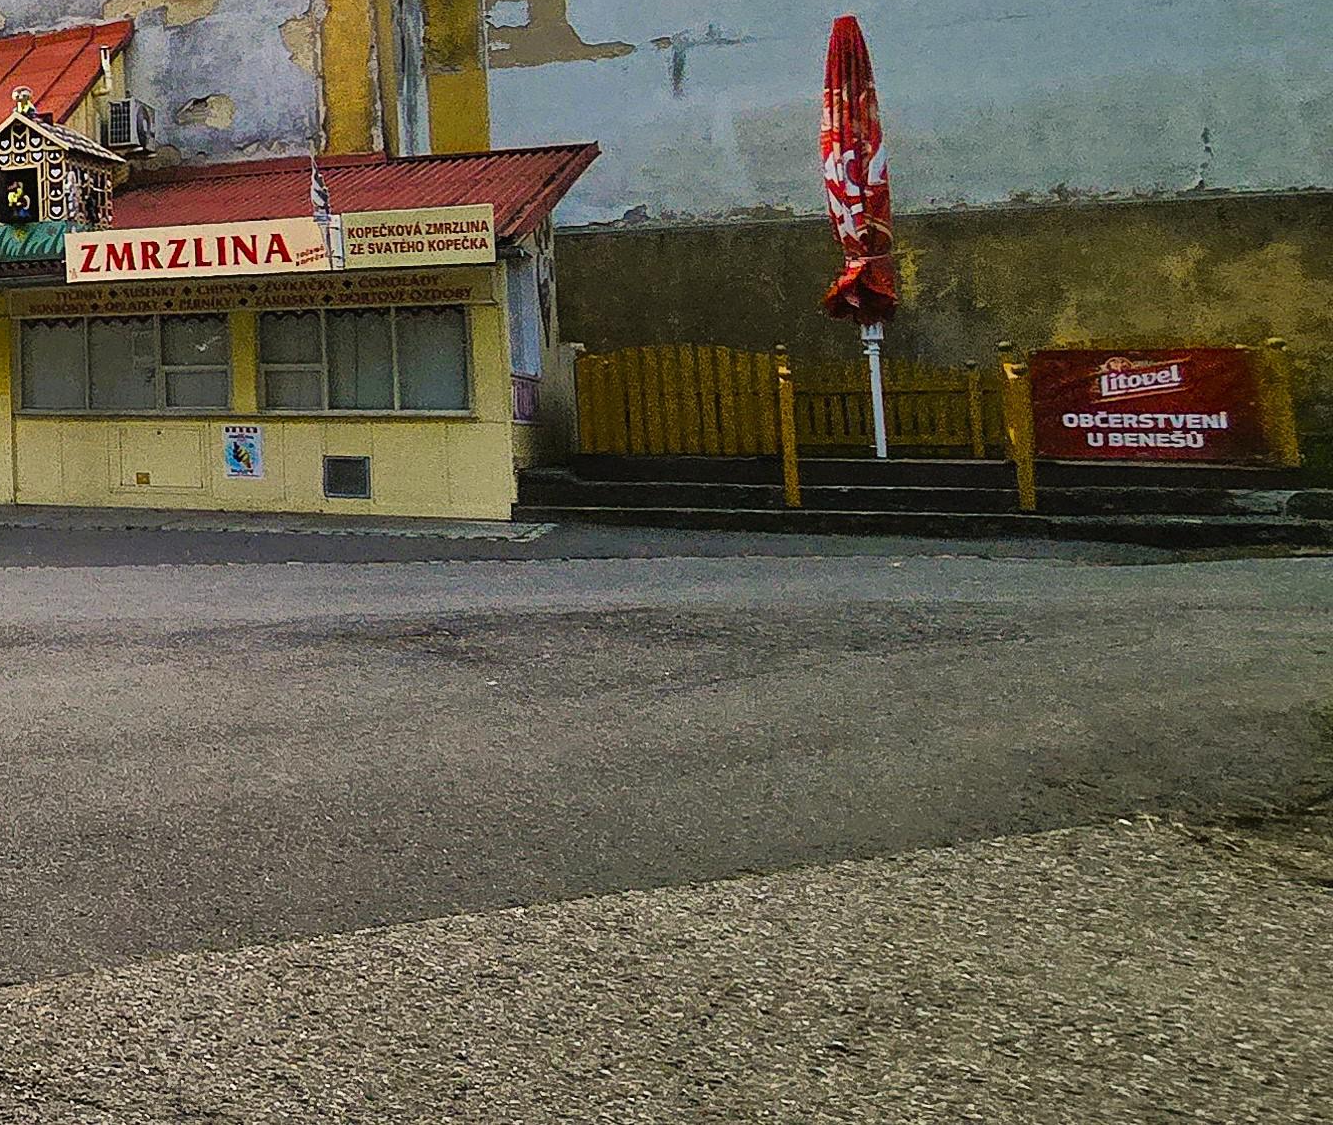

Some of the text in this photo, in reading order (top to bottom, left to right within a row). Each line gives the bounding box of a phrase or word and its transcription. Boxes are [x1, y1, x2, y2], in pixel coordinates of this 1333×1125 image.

[347, 220, 489, 239] KOPEČKOVÁ ZMRZLINA
[80, 233, 293, 273] ZMRZLINA
[349, 236, 488, 255] ZE SVATÉHO KOPEČKA
[1101, 364, 1182, 396] Litovel
[1062, 411, 1229, 429] OBČERSTVENÍ
[1087, 430, 1205, 448] U BENEŠŮ
